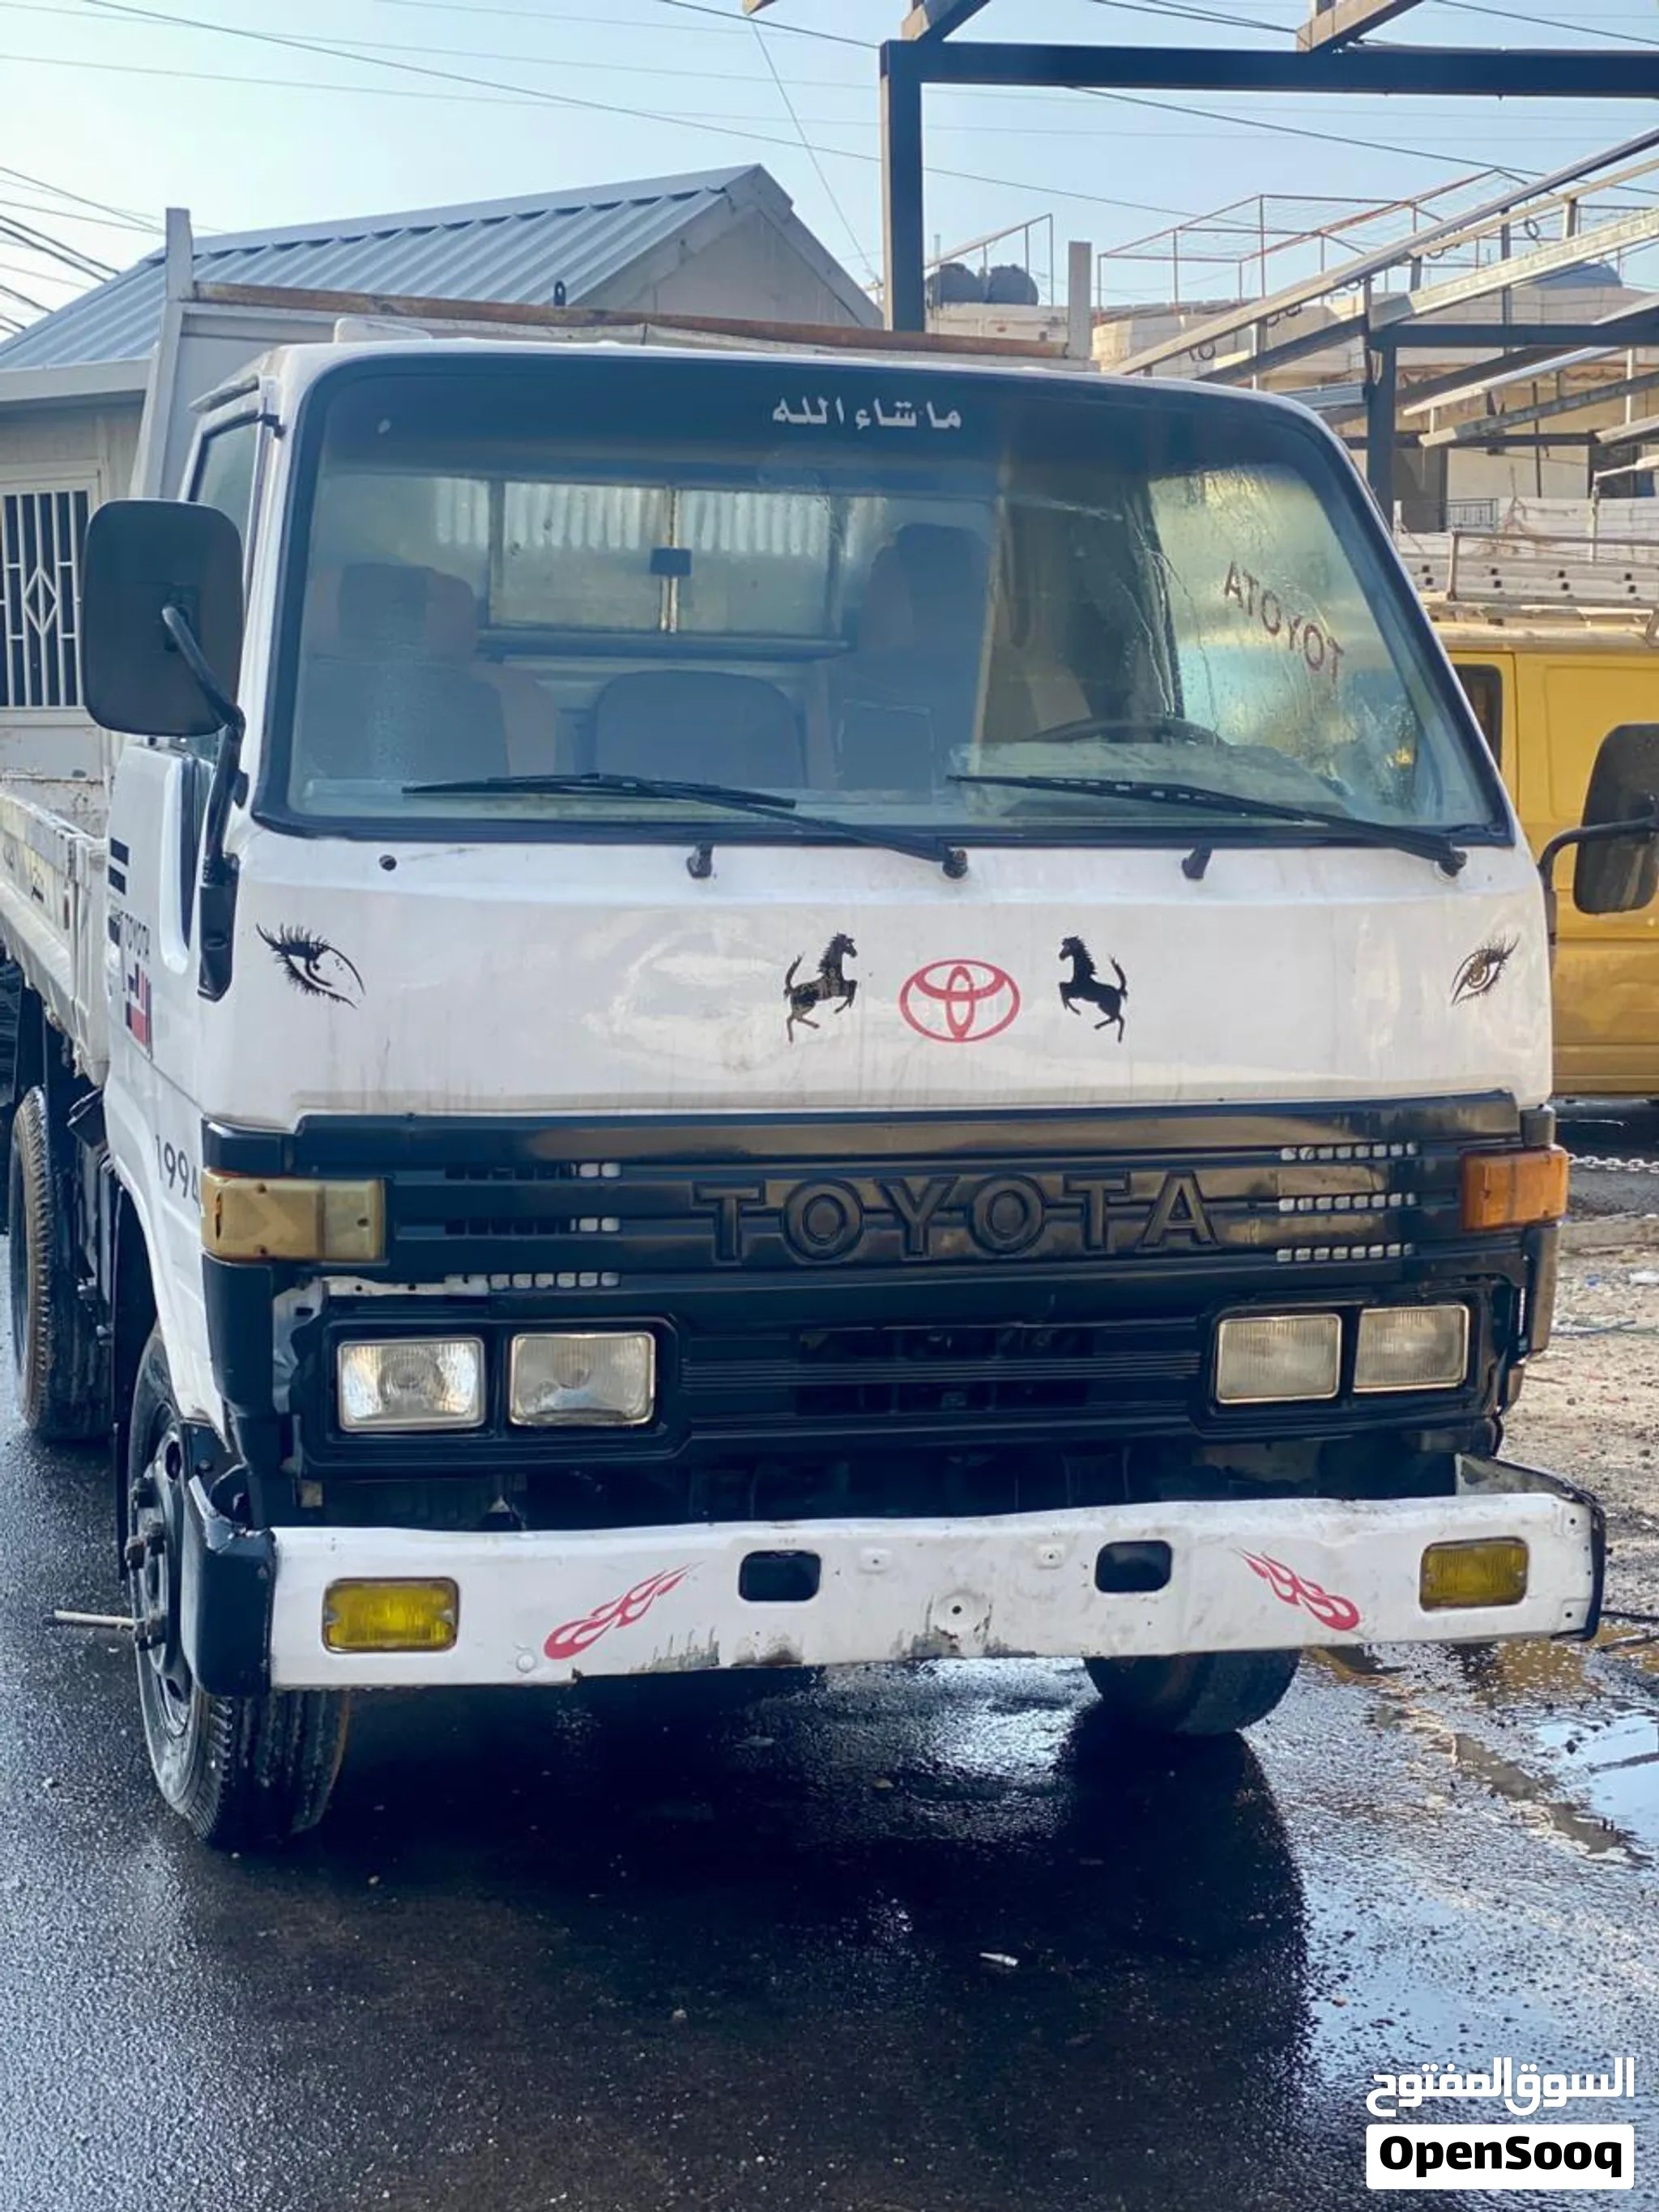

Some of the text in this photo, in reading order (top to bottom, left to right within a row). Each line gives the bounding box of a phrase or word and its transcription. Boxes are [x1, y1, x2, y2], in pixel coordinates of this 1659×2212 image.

[771, 395, 962, 430] ما شاء الله
[691, 1170, 1218, 1266] TOYOTA
